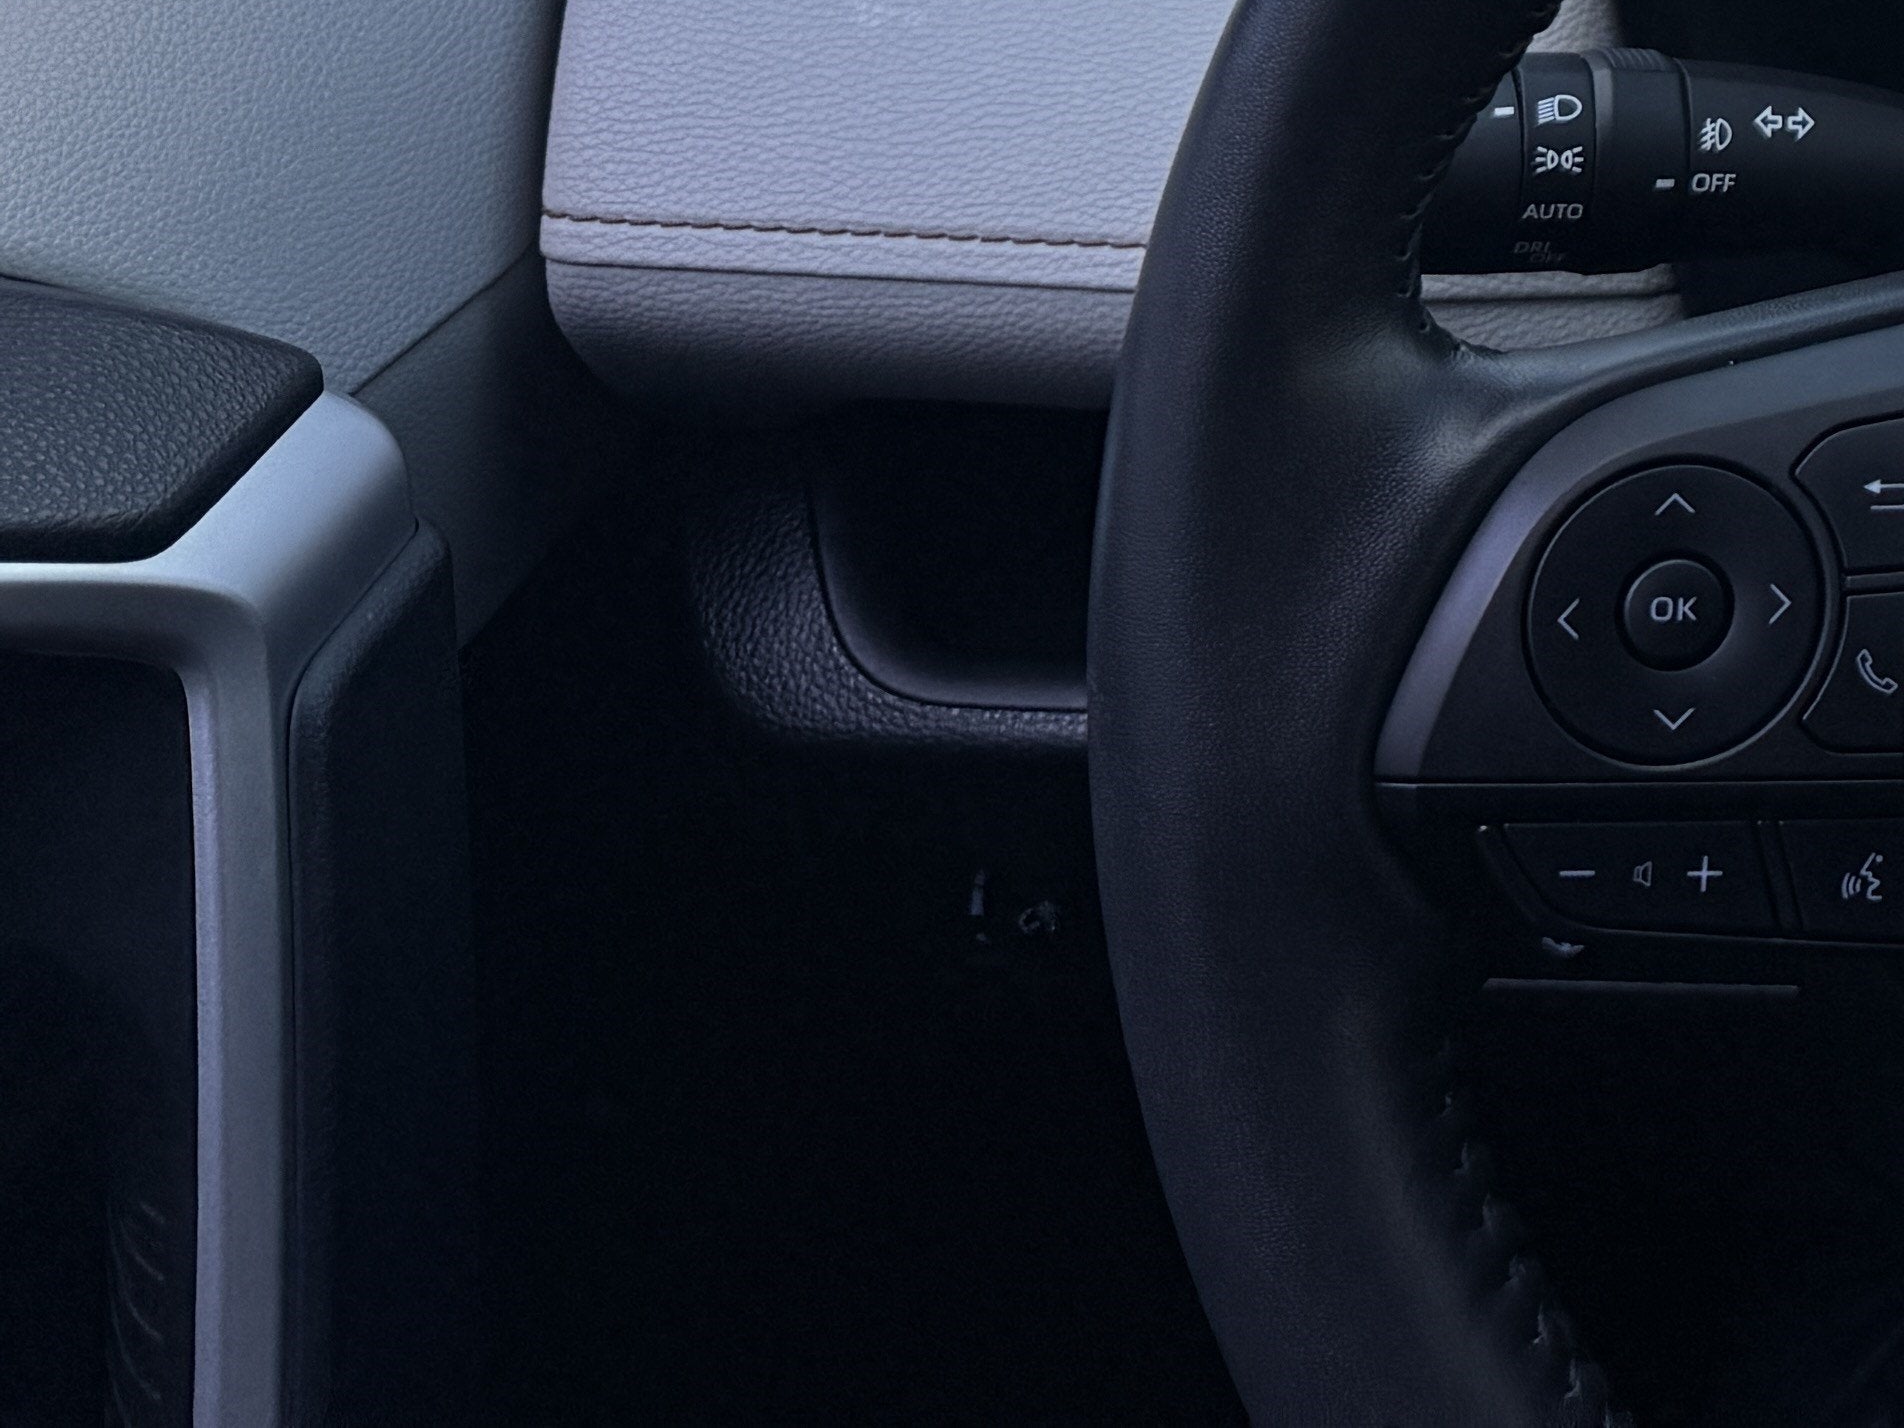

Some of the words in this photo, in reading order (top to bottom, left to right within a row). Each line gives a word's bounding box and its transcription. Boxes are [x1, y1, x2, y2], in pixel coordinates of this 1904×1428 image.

[1691, 172, 1737, 193] OFF
[1521, 203, 1584, 220] AUTO
[1649, 596, 1697, 622] OK
